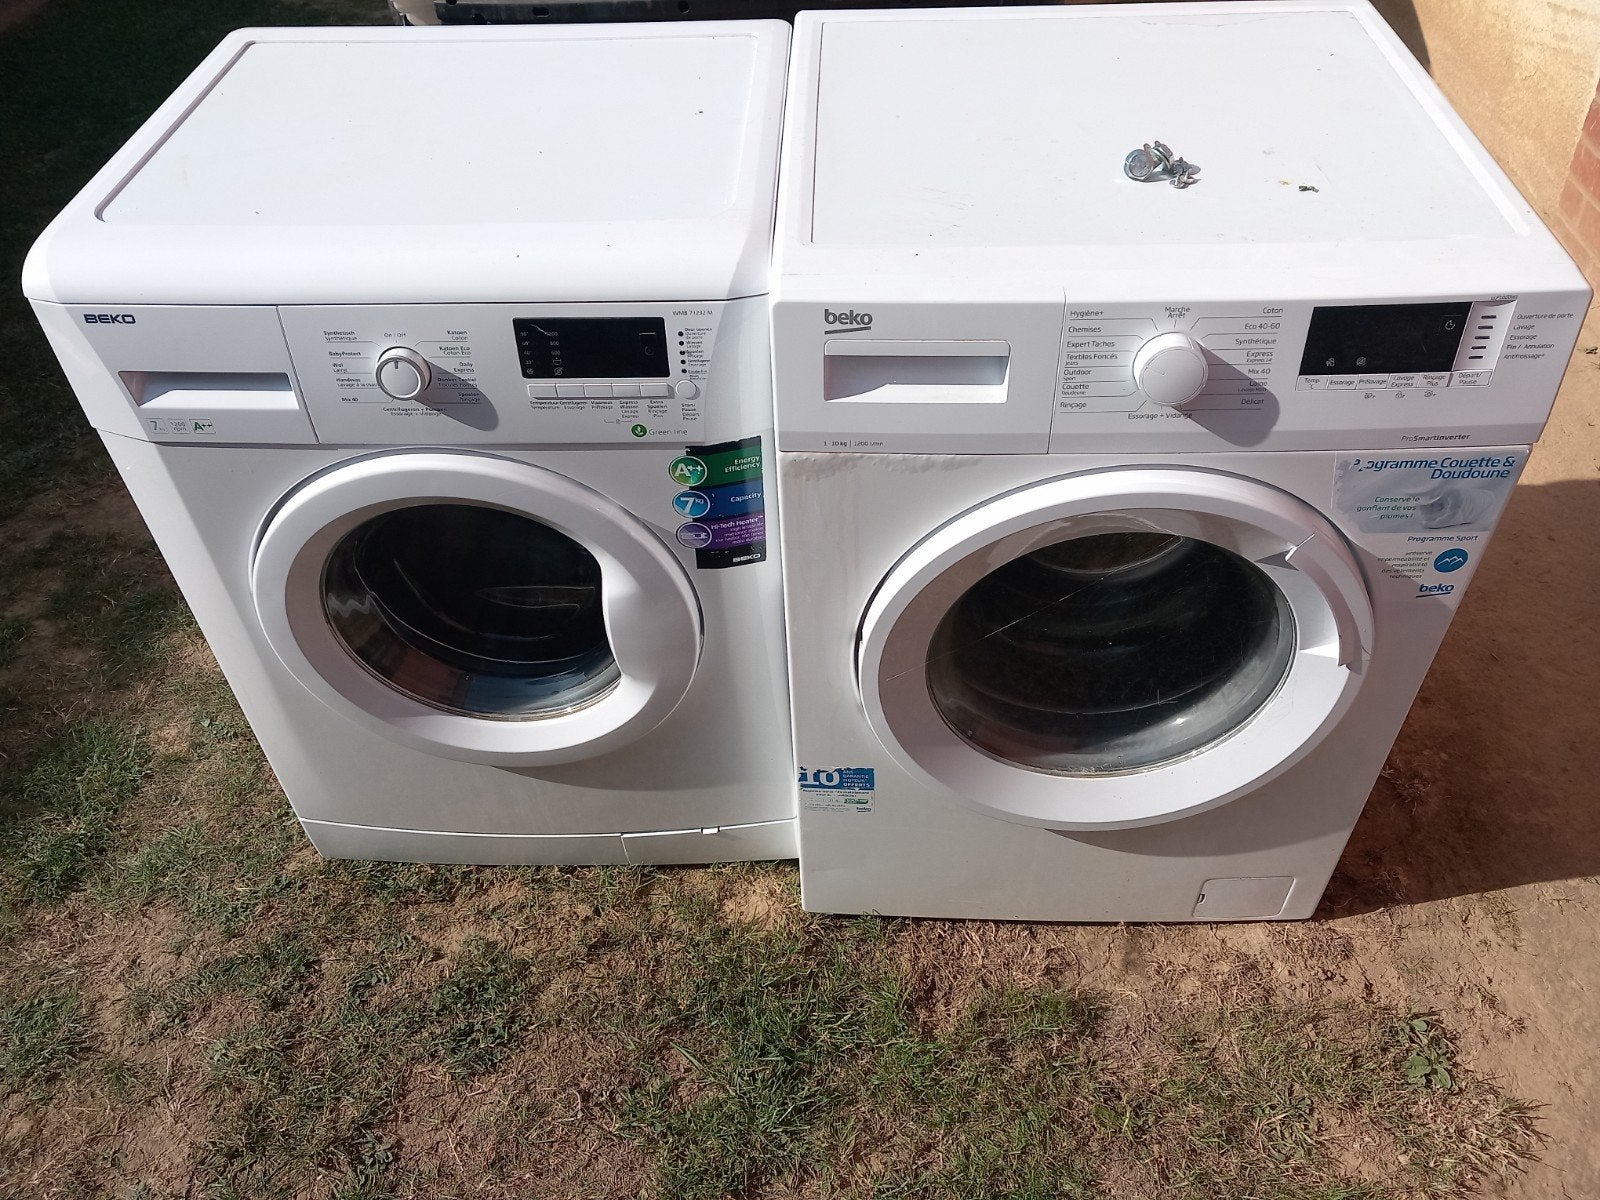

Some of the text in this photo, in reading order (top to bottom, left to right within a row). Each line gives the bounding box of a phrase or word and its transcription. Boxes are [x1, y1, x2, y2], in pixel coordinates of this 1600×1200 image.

[83, 313, 136, 324] BEKO
[824, 308, 873, 326] beko
[1070, 310, 1104, 318] Hygiène+
[1244, 322, 1281, 330] Eco 40-60
[1235, 338, 1277, 346] Synthétique
[1062, 383, 1090, 391] Couette
[193, 421, 213, 431] A++
[648, 428, 672, 436] Green
[1401, 433, 1471, 442] ProSmartInverter
[734, 455, 760, 465] Energy
[1440, 456, 1501, 468] Couette
[1502, 456, 1516, 467] &
[673, 463, 704, 477] A++
[724, 462, 761, 473] Efficiency
[1430, 468, 1510, 479] Doudoune
[730, 492, 762, 503] Capacity
[1356, 504, 1391, 513] gonflant
[1379, 512, 1409, 520] plumes
[711, 520, 735, 530] Hi-Tech
[1407, 535, 1479, 543] Programme Sport
[732, 553, 761, 563] BEKO
[1418, 583, 1455, 593] beko
